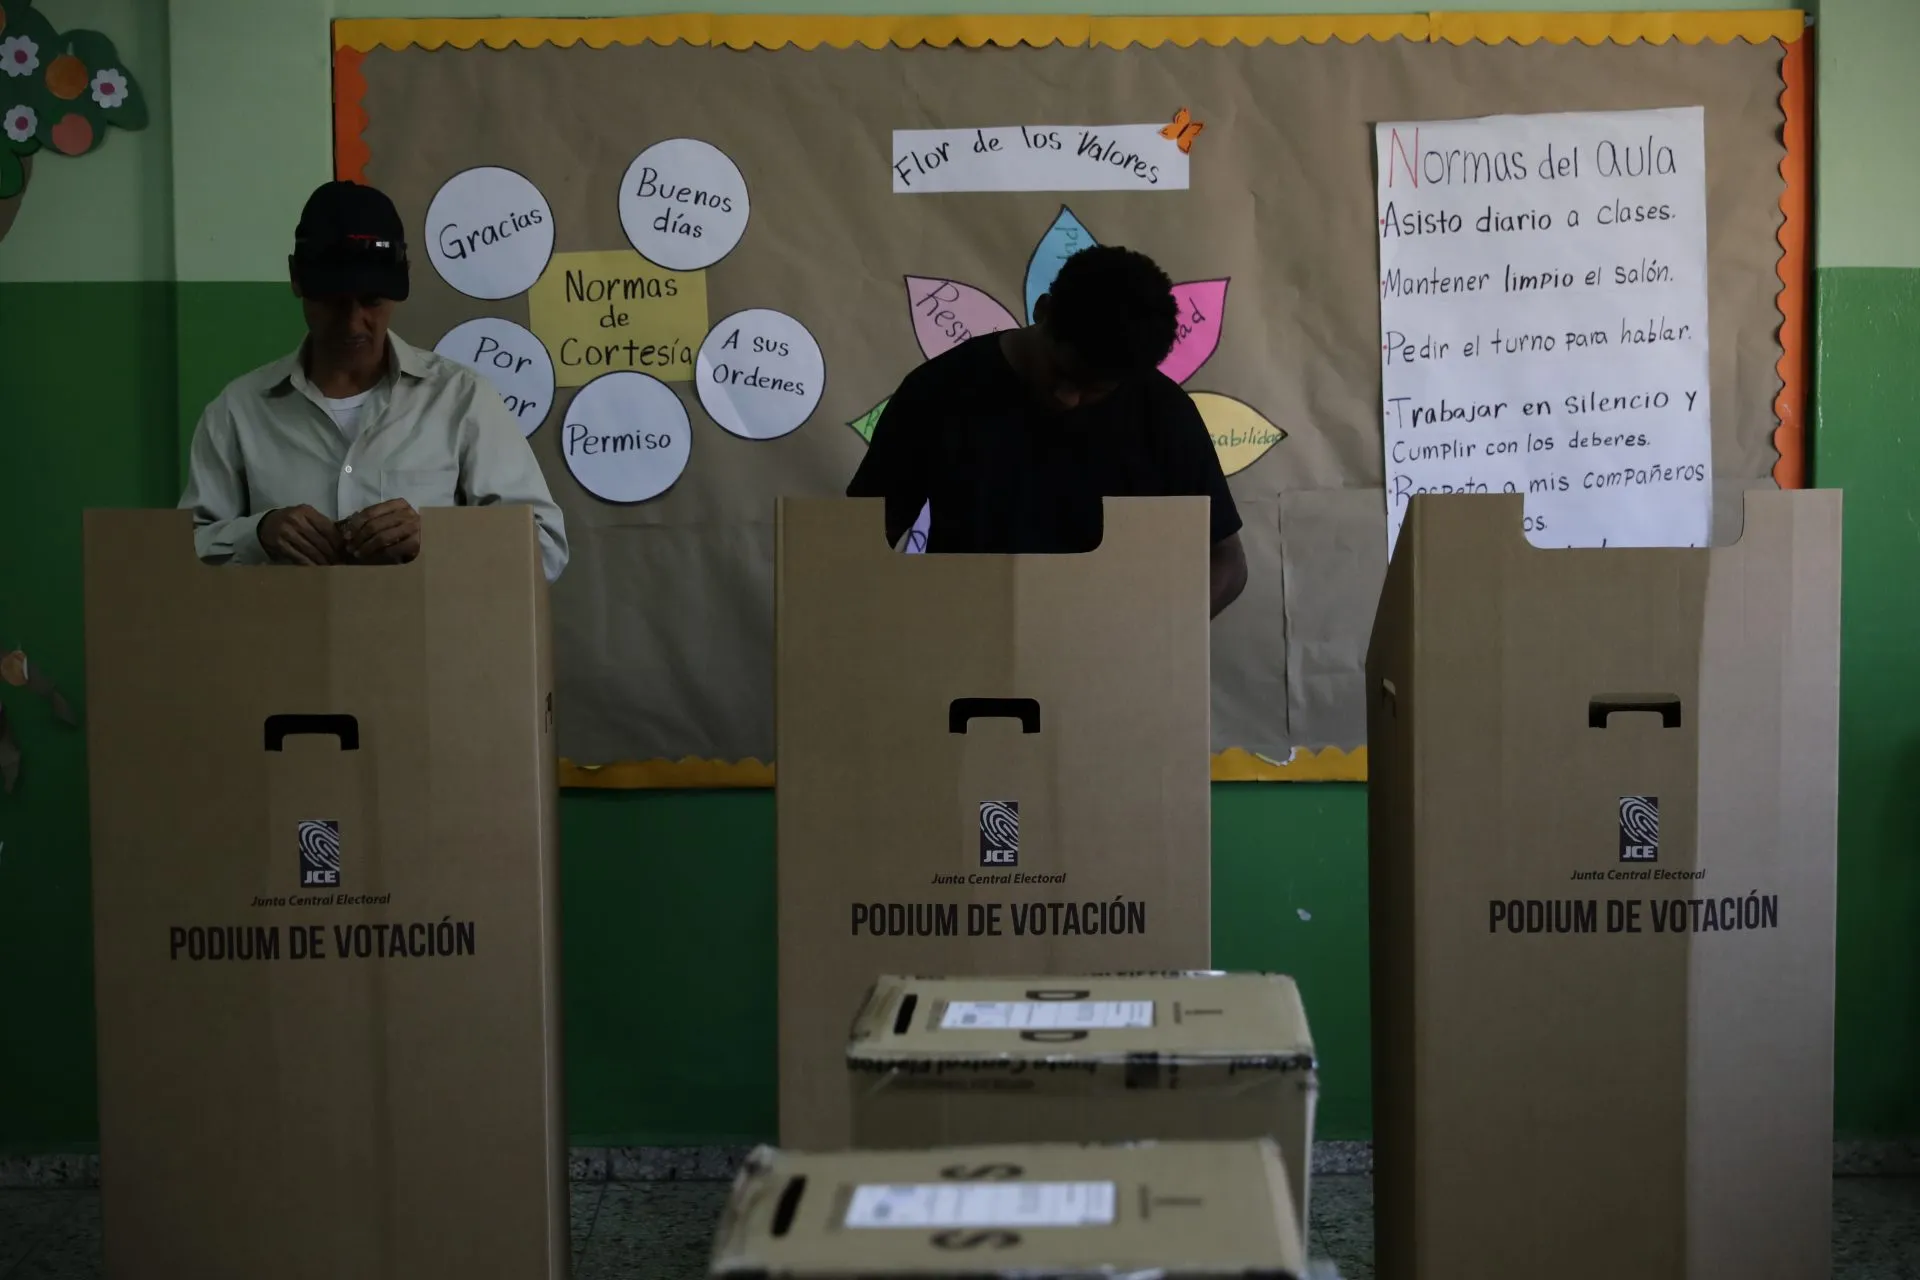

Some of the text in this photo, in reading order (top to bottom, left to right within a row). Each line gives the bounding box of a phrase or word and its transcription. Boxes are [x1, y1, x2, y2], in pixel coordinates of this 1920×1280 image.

[893, 125, 1160, 187] Flor de los Valores
[1389, 127, 1528, 189] Normas
[1538, 142, 1579, 180] del
[636, 167, 733, 213] Buenos
[439, 209, 543, 260] Gracias
[653, 207, 703, 239] días
[1383, 201, 1462, 238] Asisto
[1475, 205, 1552, 233] diario
[1567, 210, 1580, 228] a
[565, 270, 678, 303] Normas
[1383, 266, 1490, 299] Mantener
[1504, 264, 1574, 293] limpio
[1585, 266, 1602, 286] el
[600, 304, 630, 329] de
[473, 336, 533, 374] Por
[560, 337, 693, 368] Cortesía
[721, 329, 790, 357] A sus
[1386, 316, 1692, 366] Pedir el turno para hablar.
[712, 363, 806, 397] Ordenes
[1388, 397, 1507, 428] Trabajar
[1522, 402, 1552, 417] en
[566, 424, 671, 457] Permiso
[1392, 431, 1651, 464] Cumplir con los deberes.
[1529, 473, 1570, 494] mis
[983, 850, 1015, 863] JCE
[1621, 845, 1655, 860] JCE
[303, 870, 337, 885] JCE
[931, 873, 1067, 885] Junta Central Electoral
[1570, 868, 1706, 881] Junta Central Electoral
[251, 893, 391, 907] Junta Central Electoral
[851, 895, 1146, 936] PODIUM DE VOTACIÓN
[1489, 889, 1778, 933] PODIUM DE VOTACIÓN
[170, 916, 476, 961] PODIUM DE VOTACIÓN
